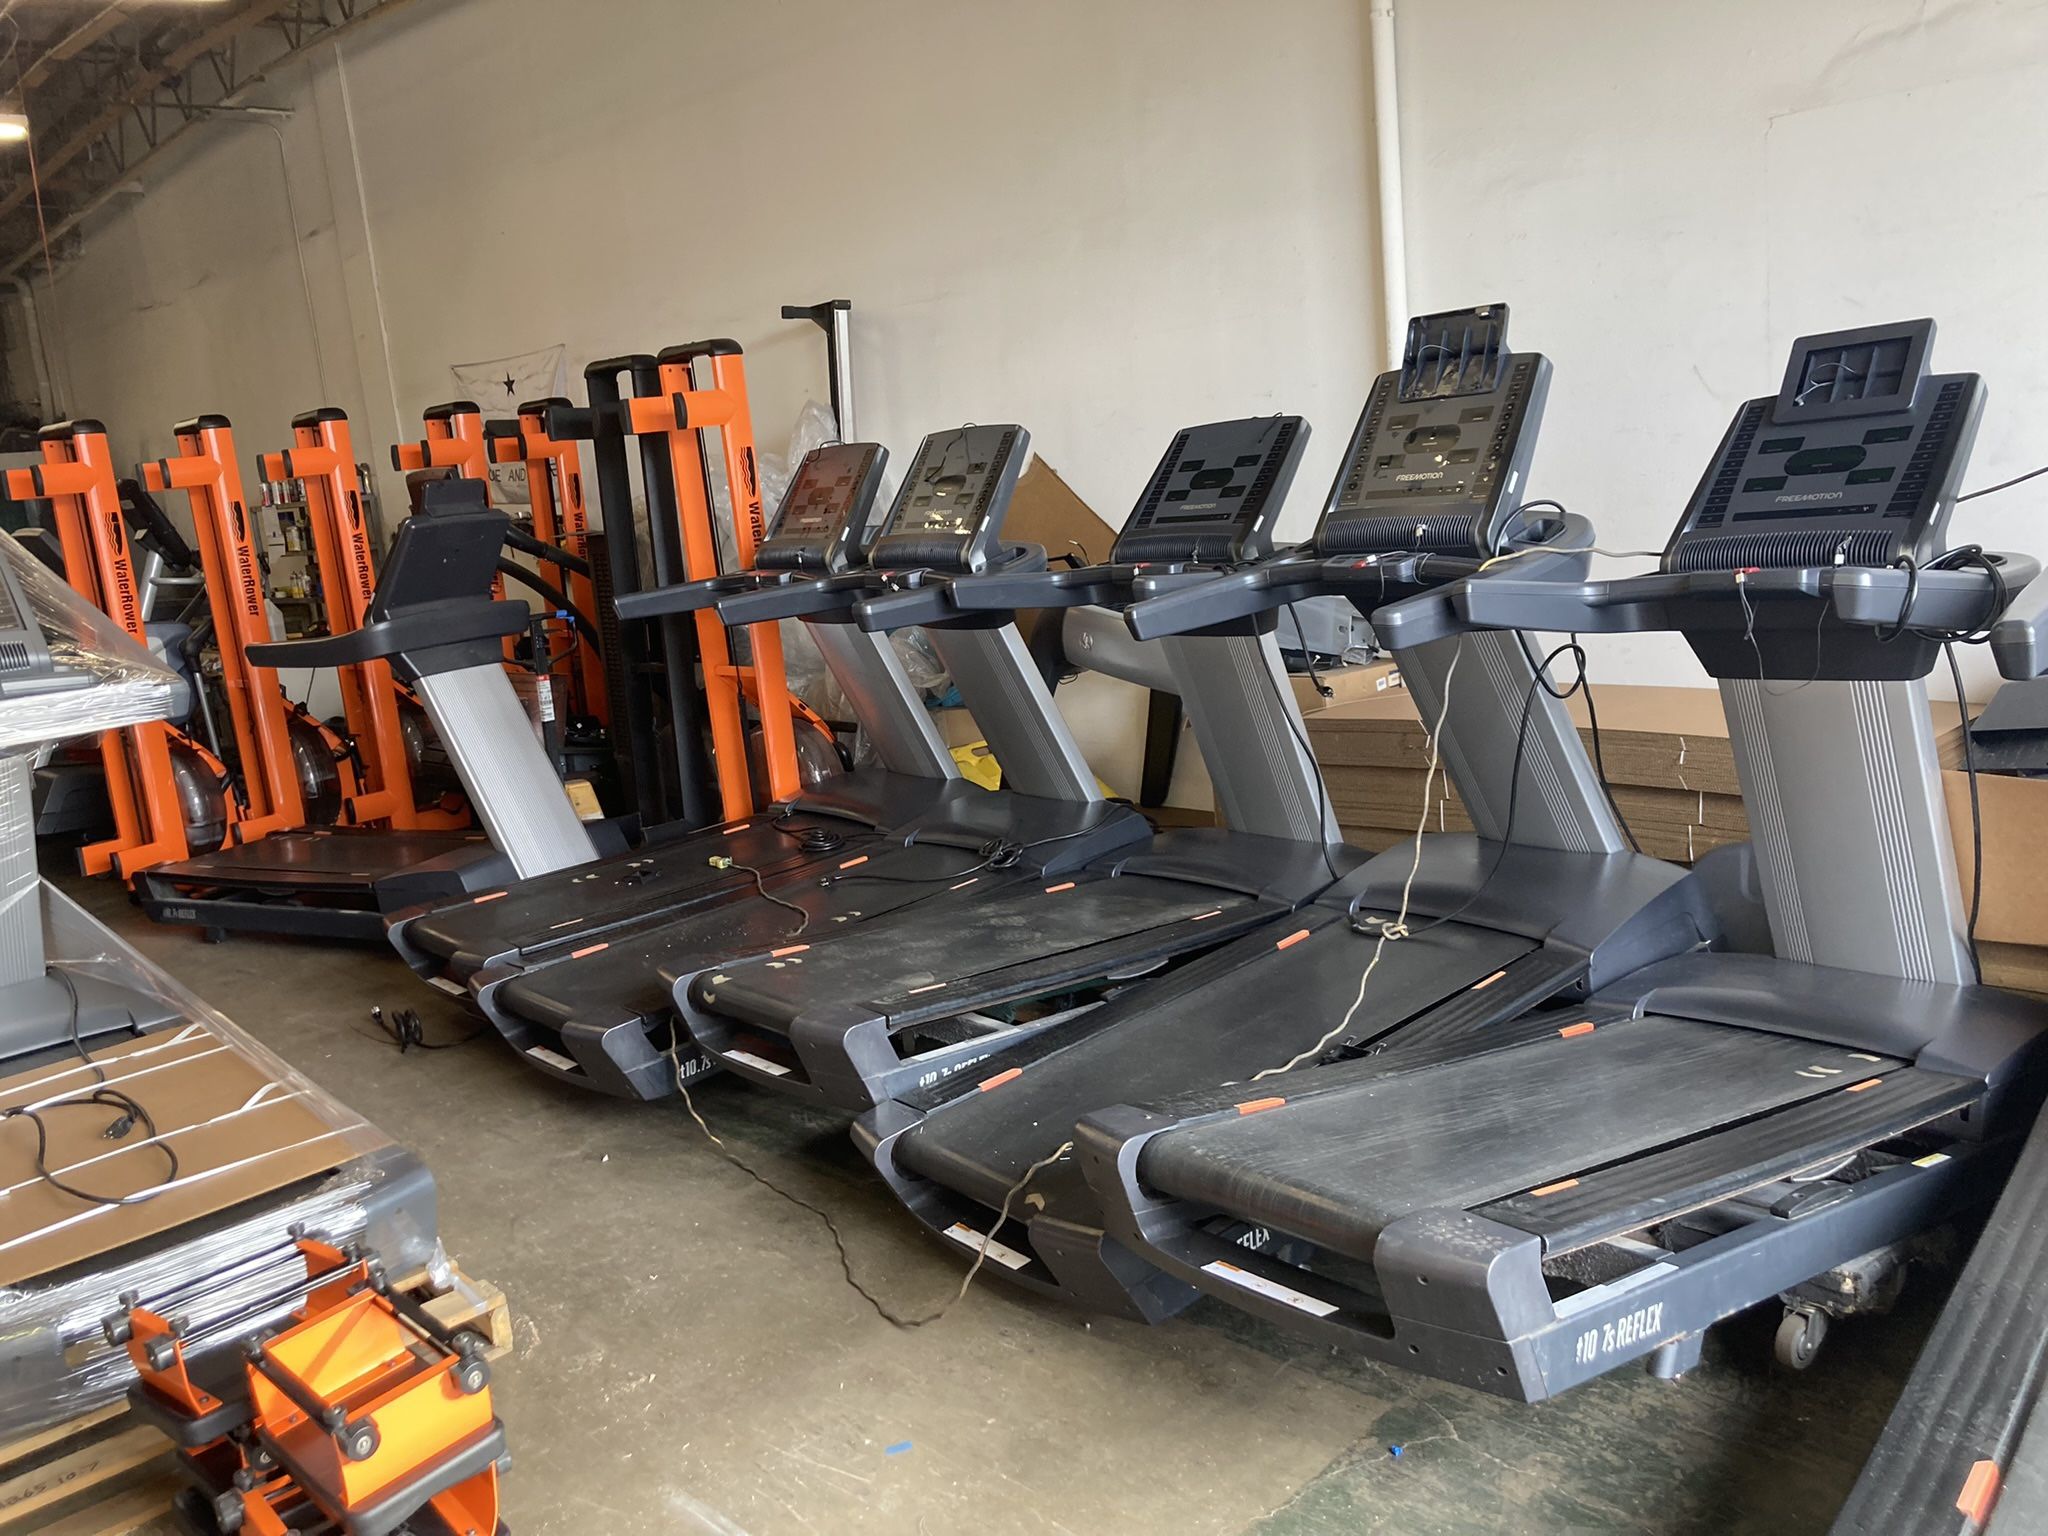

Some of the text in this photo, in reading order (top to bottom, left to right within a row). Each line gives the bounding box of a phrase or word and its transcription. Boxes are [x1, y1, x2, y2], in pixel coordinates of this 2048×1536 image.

[508, 468, 526, 481] AND
[1396, 471, 1443, 482] FREEMOTION
[1775, 491, 1843, 503] FREEMOTION
[114, 559, 139, 634] WaterRower
[237, 545, 260, 617] WaterRower
[1616, 1301, 1664, 1350] REFLEX
